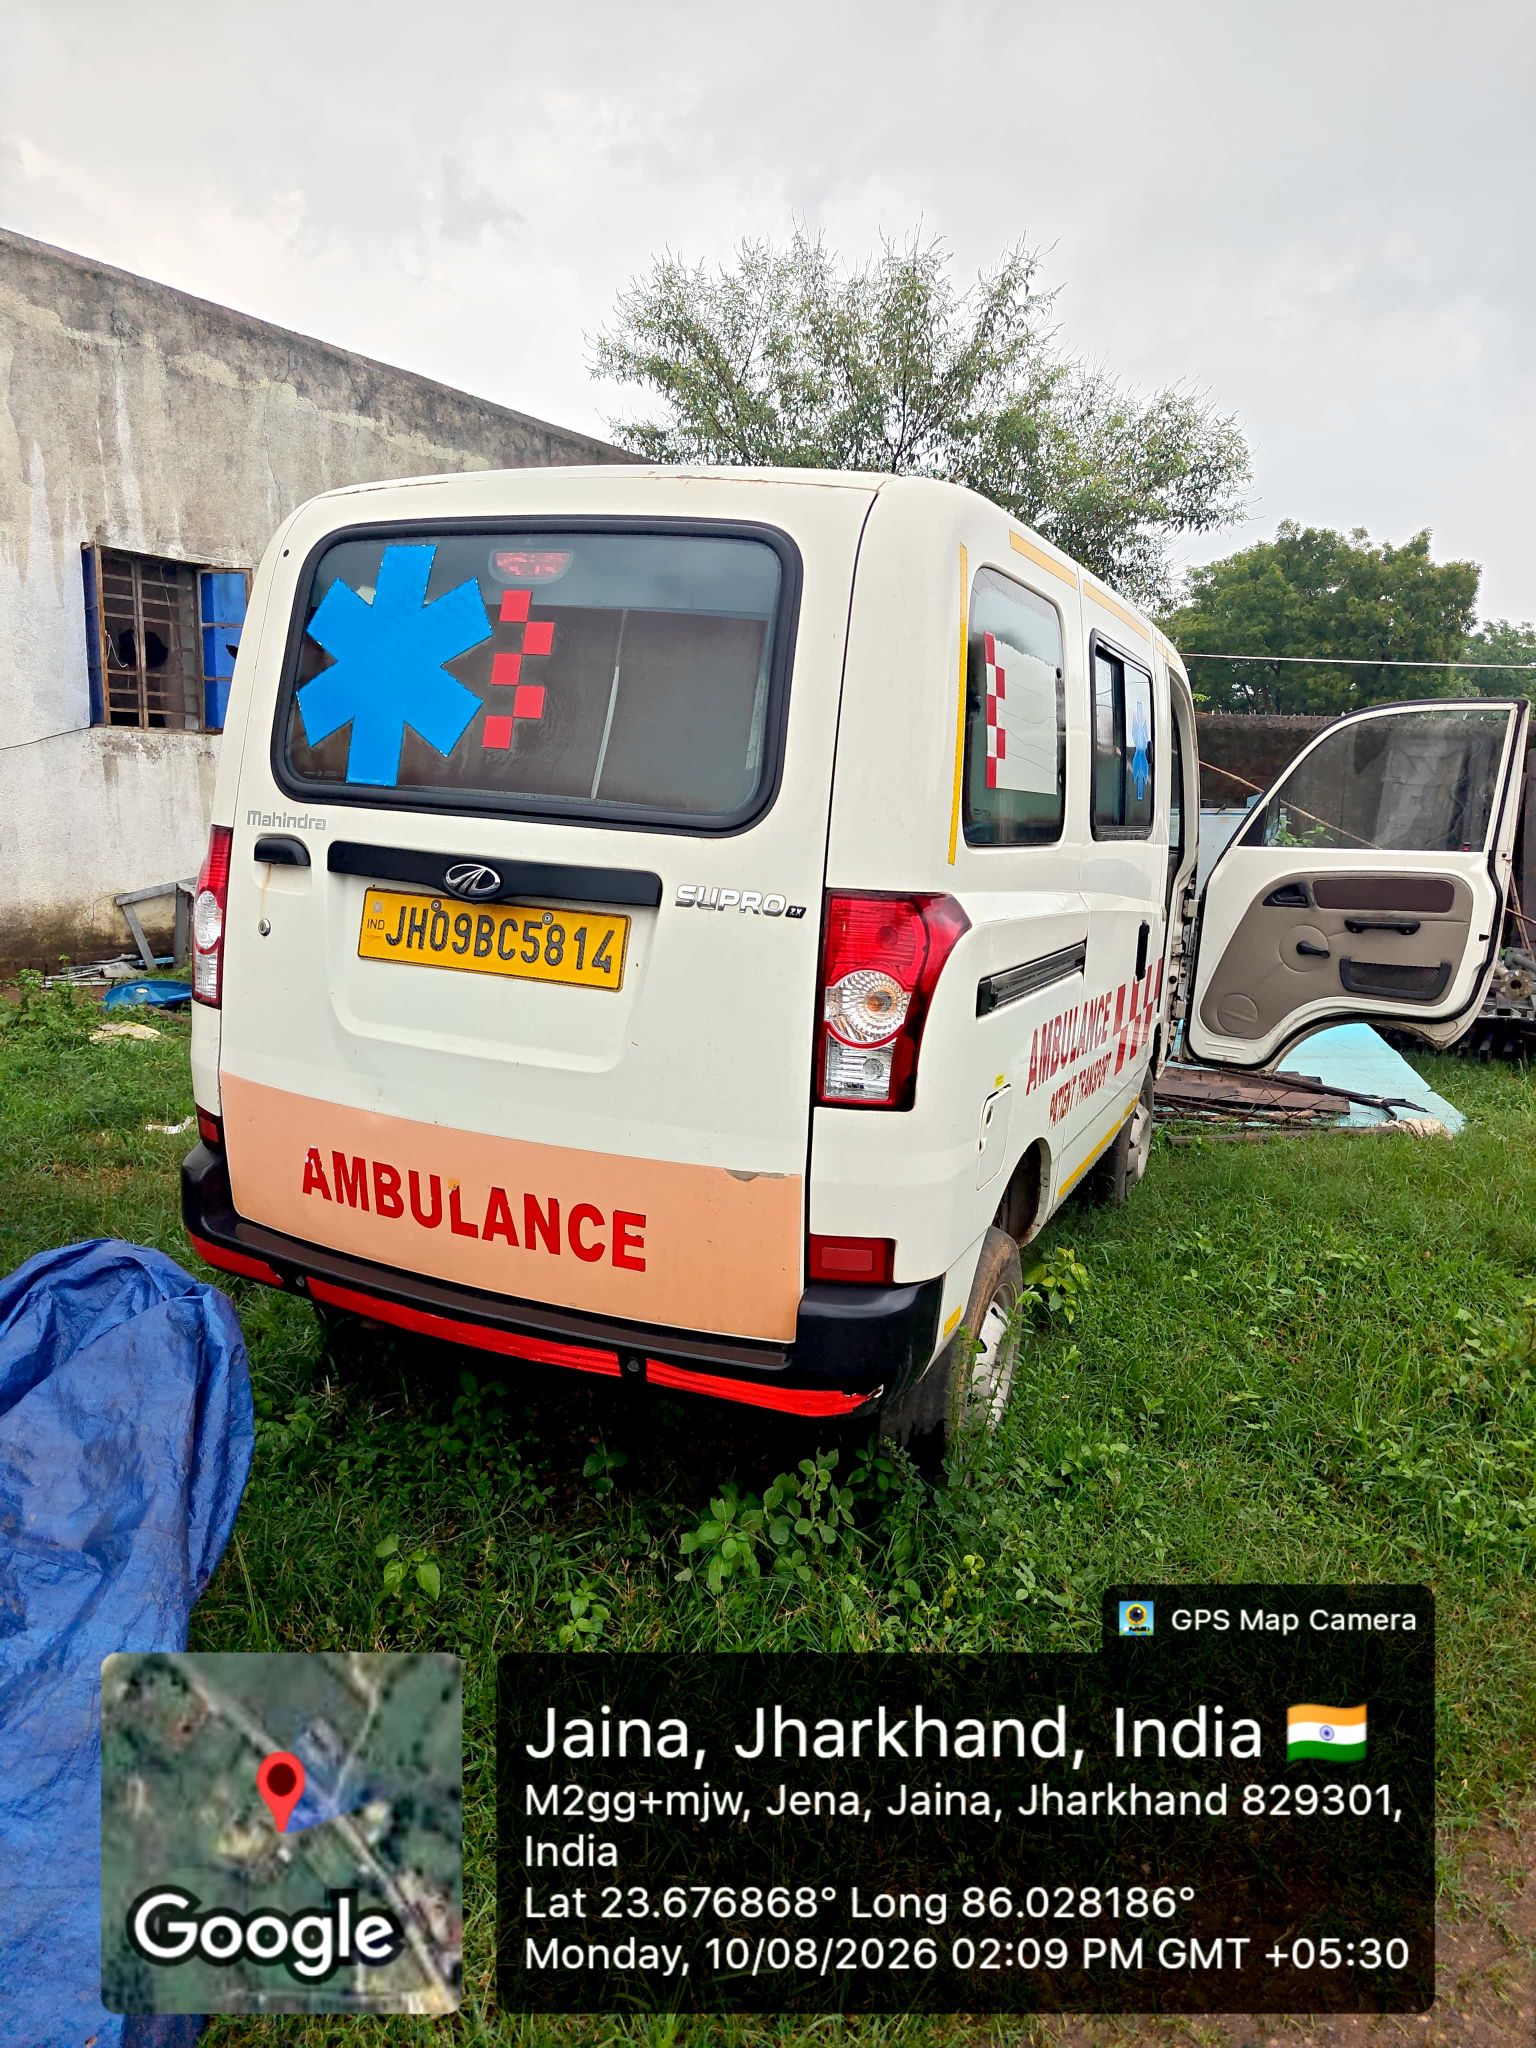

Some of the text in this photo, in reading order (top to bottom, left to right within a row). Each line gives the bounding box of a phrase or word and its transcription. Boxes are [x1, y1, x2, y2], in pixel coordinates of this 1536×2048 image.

[247, 810, 327, 831] Mahindra
[367, 918, 385, 931] IND
[675, 885, 786, 917] SUPRO
[385, 905, 615, 974] JH09BC5814
[1025, 991, 1113, 1096] AMBULANCE
[302, 1146, 647, 1273] AMBULANCE
